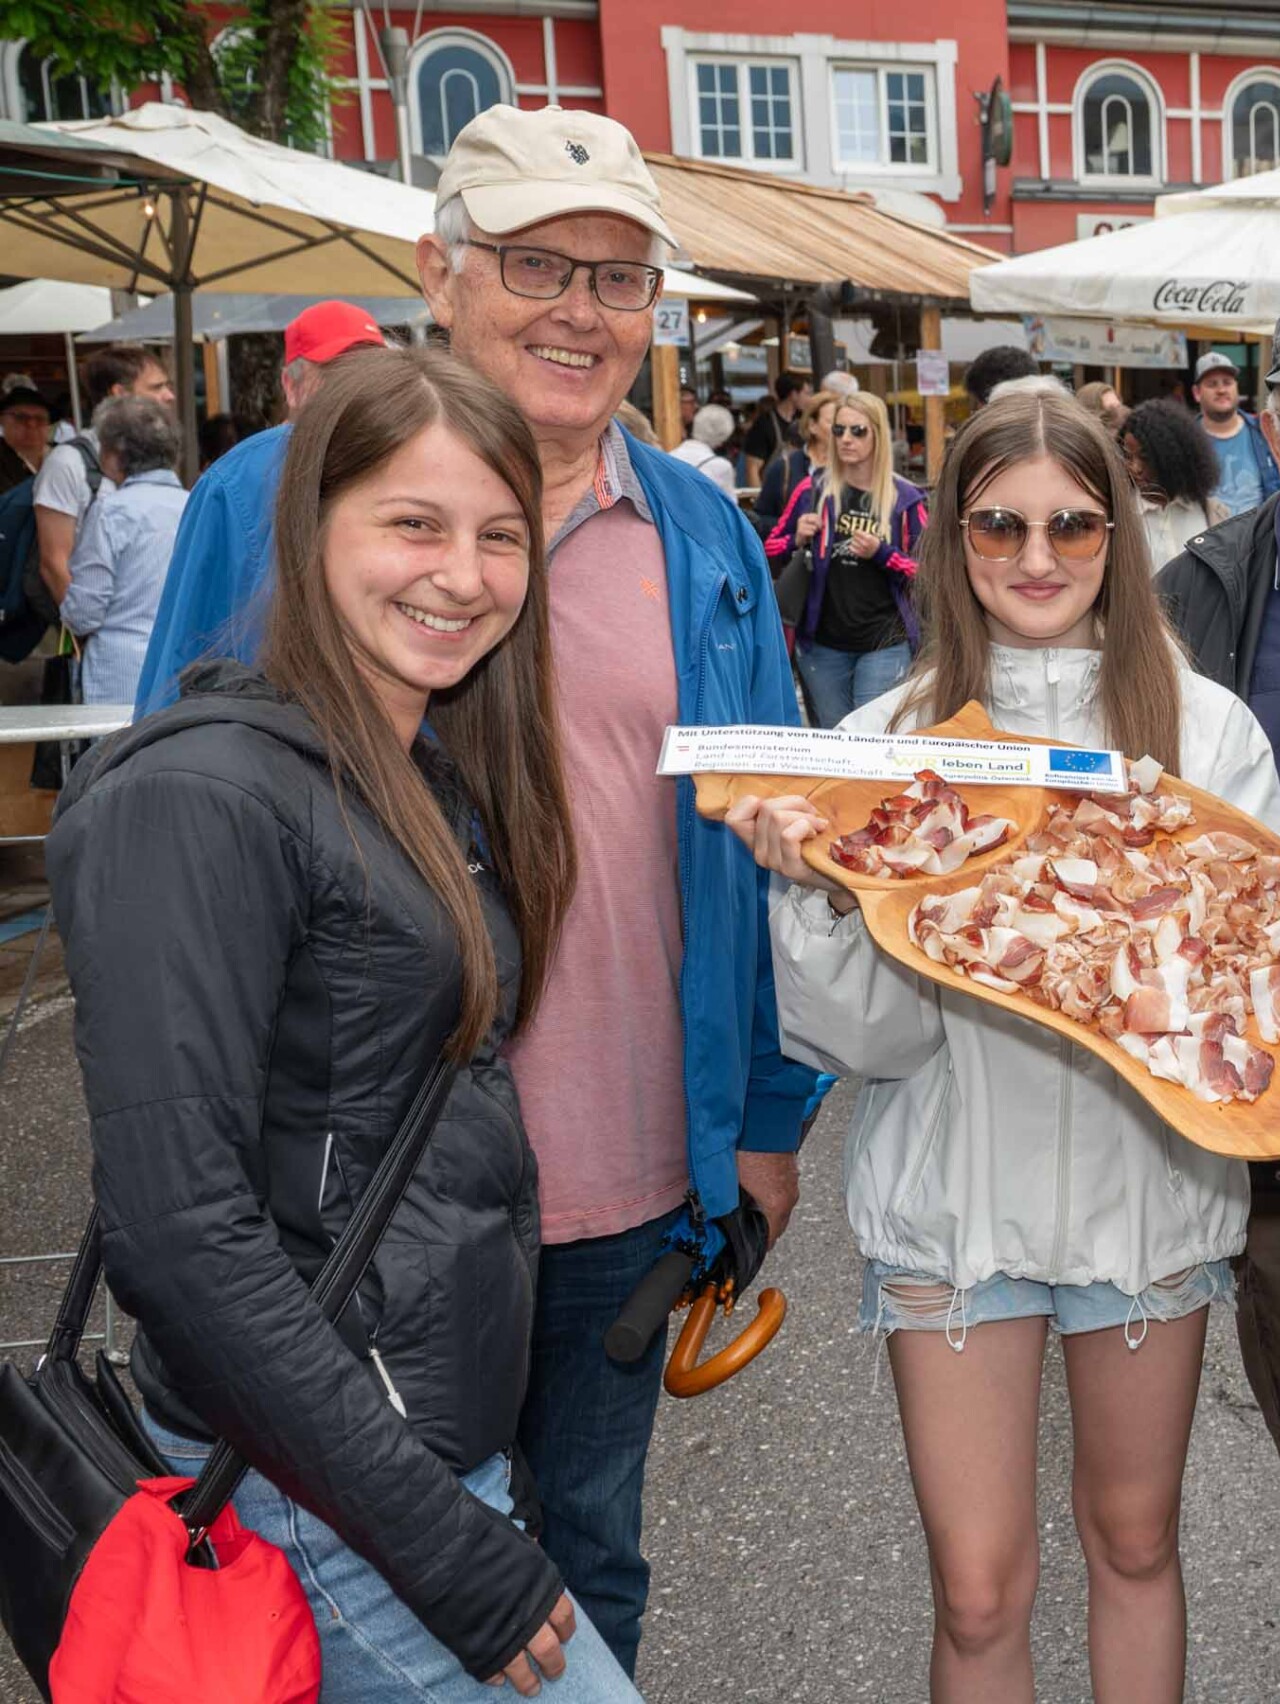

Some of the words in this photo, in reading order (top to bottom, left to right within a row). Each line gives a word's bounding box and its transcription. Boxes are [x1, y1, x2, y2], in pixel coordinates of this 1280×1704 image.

[658, 311, 682, 329] 27
[698, 743, 811, 753] Bundesministerium
[701, 729, 784, 738] Unterstützung
[812, 732, 844, 742] Bund,
[848, 735, 894, 744] Ländern
[922, 739, 995, 750] Europäischer
[997, 744, 1031, 752] Union
[942, 759, 983, 769] leben
[988, 762, 1023, 771] Land
